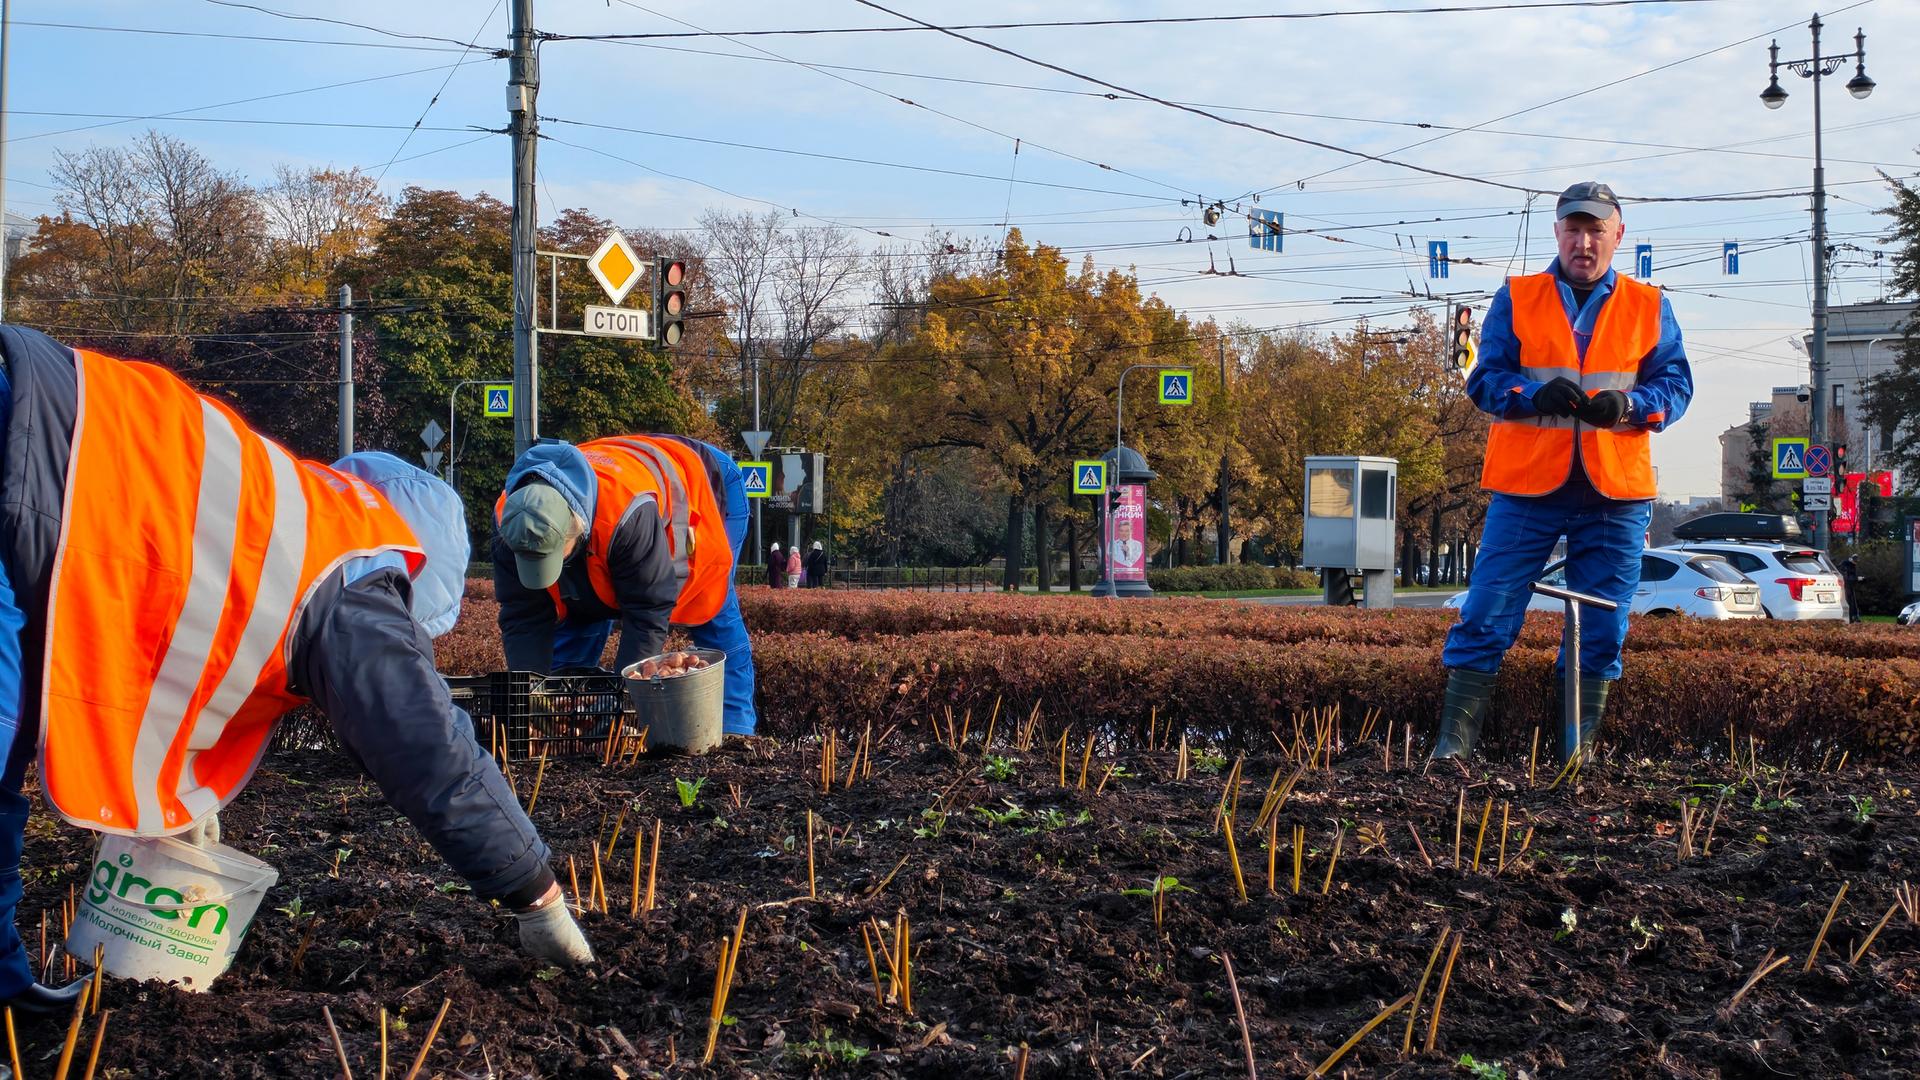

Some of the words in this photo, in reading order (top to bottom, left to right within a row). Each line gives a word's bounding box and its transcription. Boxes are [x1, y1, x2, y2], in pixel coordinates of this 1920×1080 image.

[594, 311, 639, 333] СТОП
[89, 912, 161, 950] Молочный
[166, 944, 209, 965] Завод
[111, 905, 163, 931] молекула
[166, 926, 217, 946] здоровья
